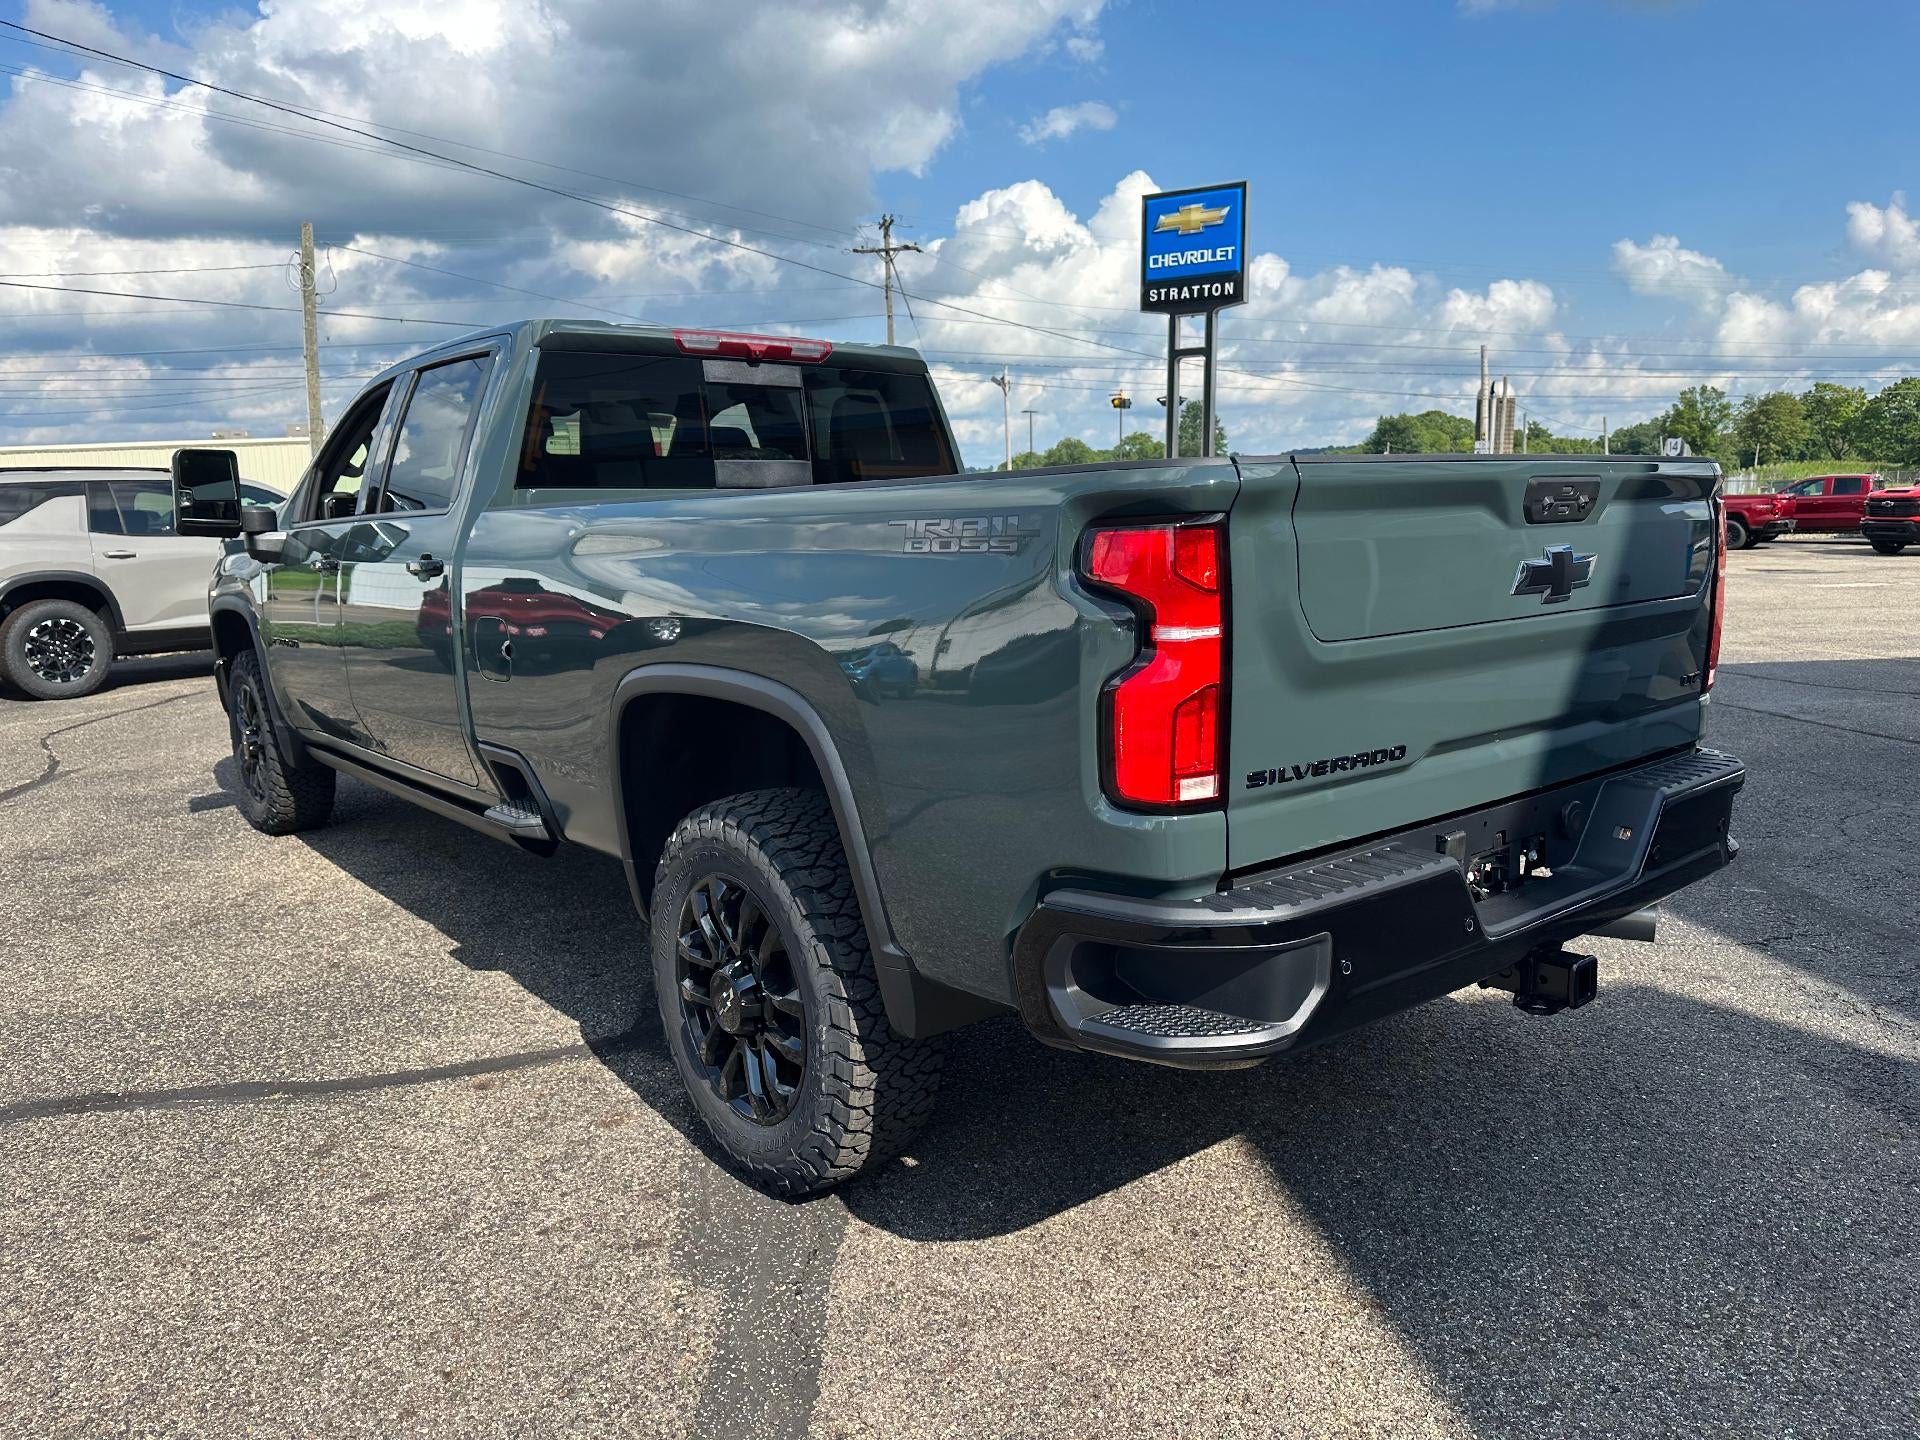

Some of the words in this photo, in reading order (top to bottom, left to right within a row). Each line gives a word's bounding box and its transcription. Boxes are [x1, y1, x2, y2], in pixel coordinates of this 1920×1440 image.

[1149, 246, 1235, 268] CHEVROLET
[1149, 281, 1234, 302] STRATTON
[888, 514, 1040, 538] TRAIL
[903, 536, 1019, 554] BOSS
[1246, 744, 1407, 789] SILVERADO
